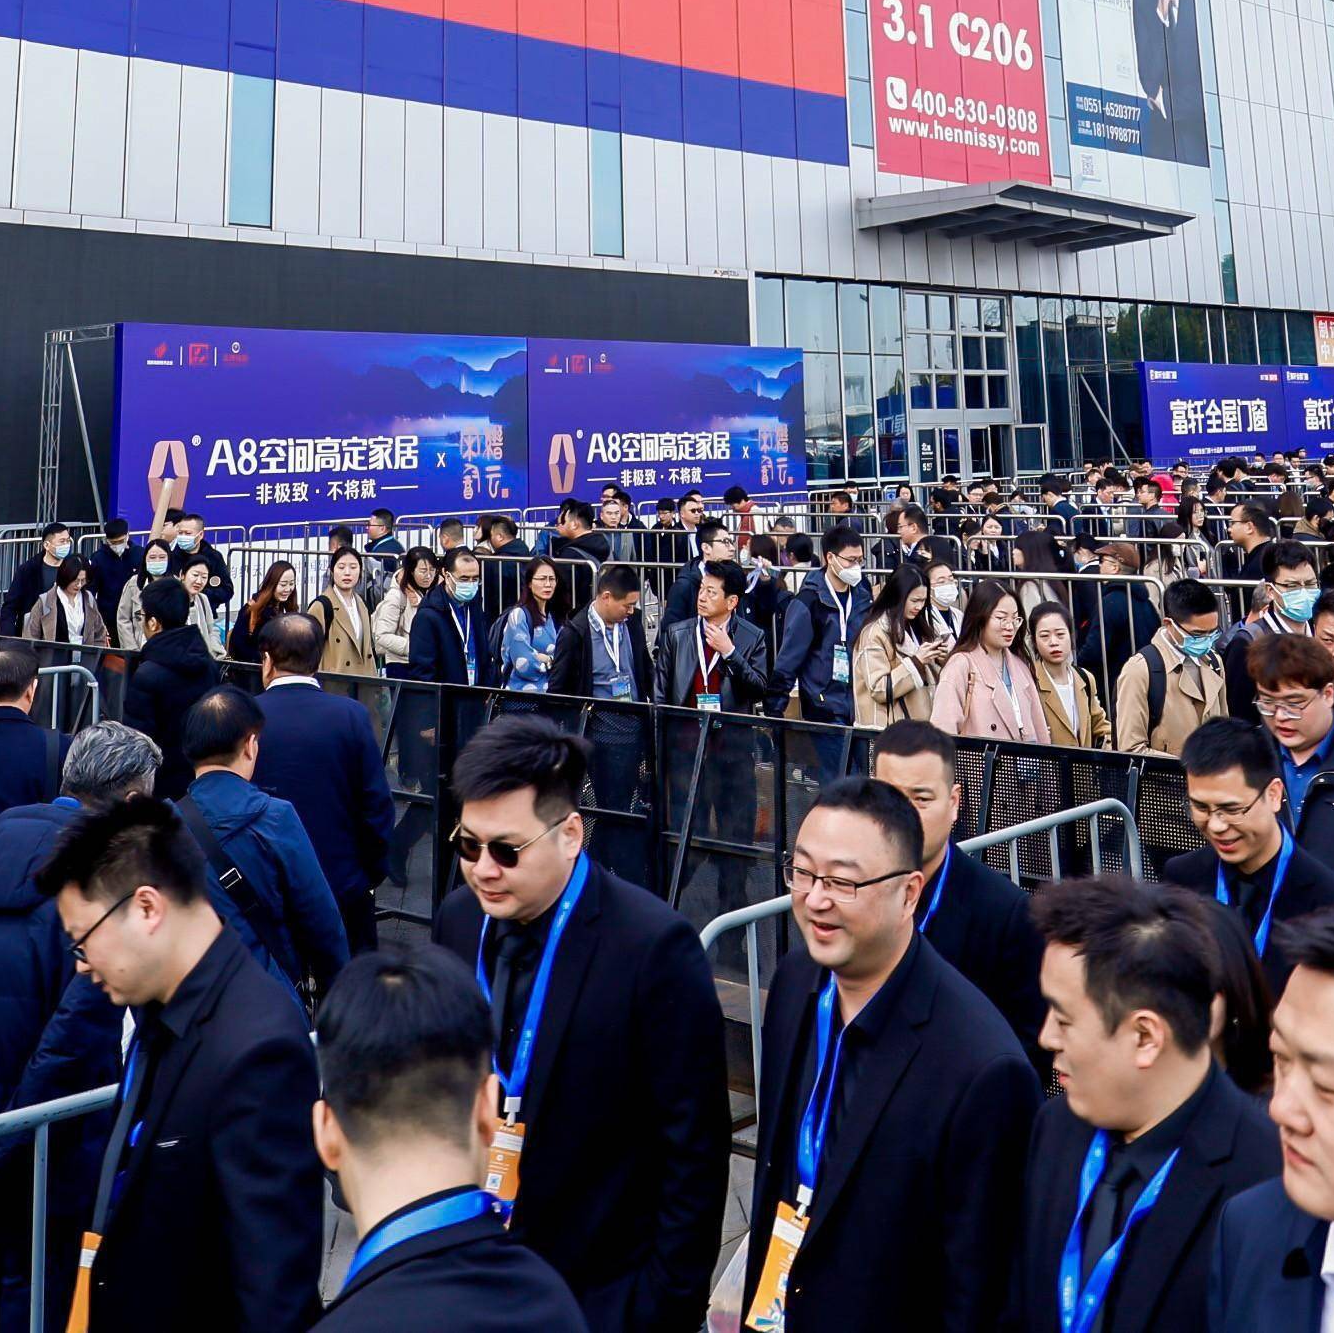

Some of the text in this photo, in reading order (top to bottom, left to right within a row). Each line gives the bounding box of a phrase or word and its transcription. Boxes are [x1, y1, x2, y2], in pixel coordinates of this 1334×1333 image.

[949, 11, 1034, 71] C206
[911, 88, 1038, 134] 400-830-0808
[888, 116, 1041, 156] www.hennissy.com
[1170, 398, 1268, 435] 富轩全屋门窗
[206, 435, 418, 476] A8空间高定家居
[587, 431, 731, 464] A8空间高定家居
